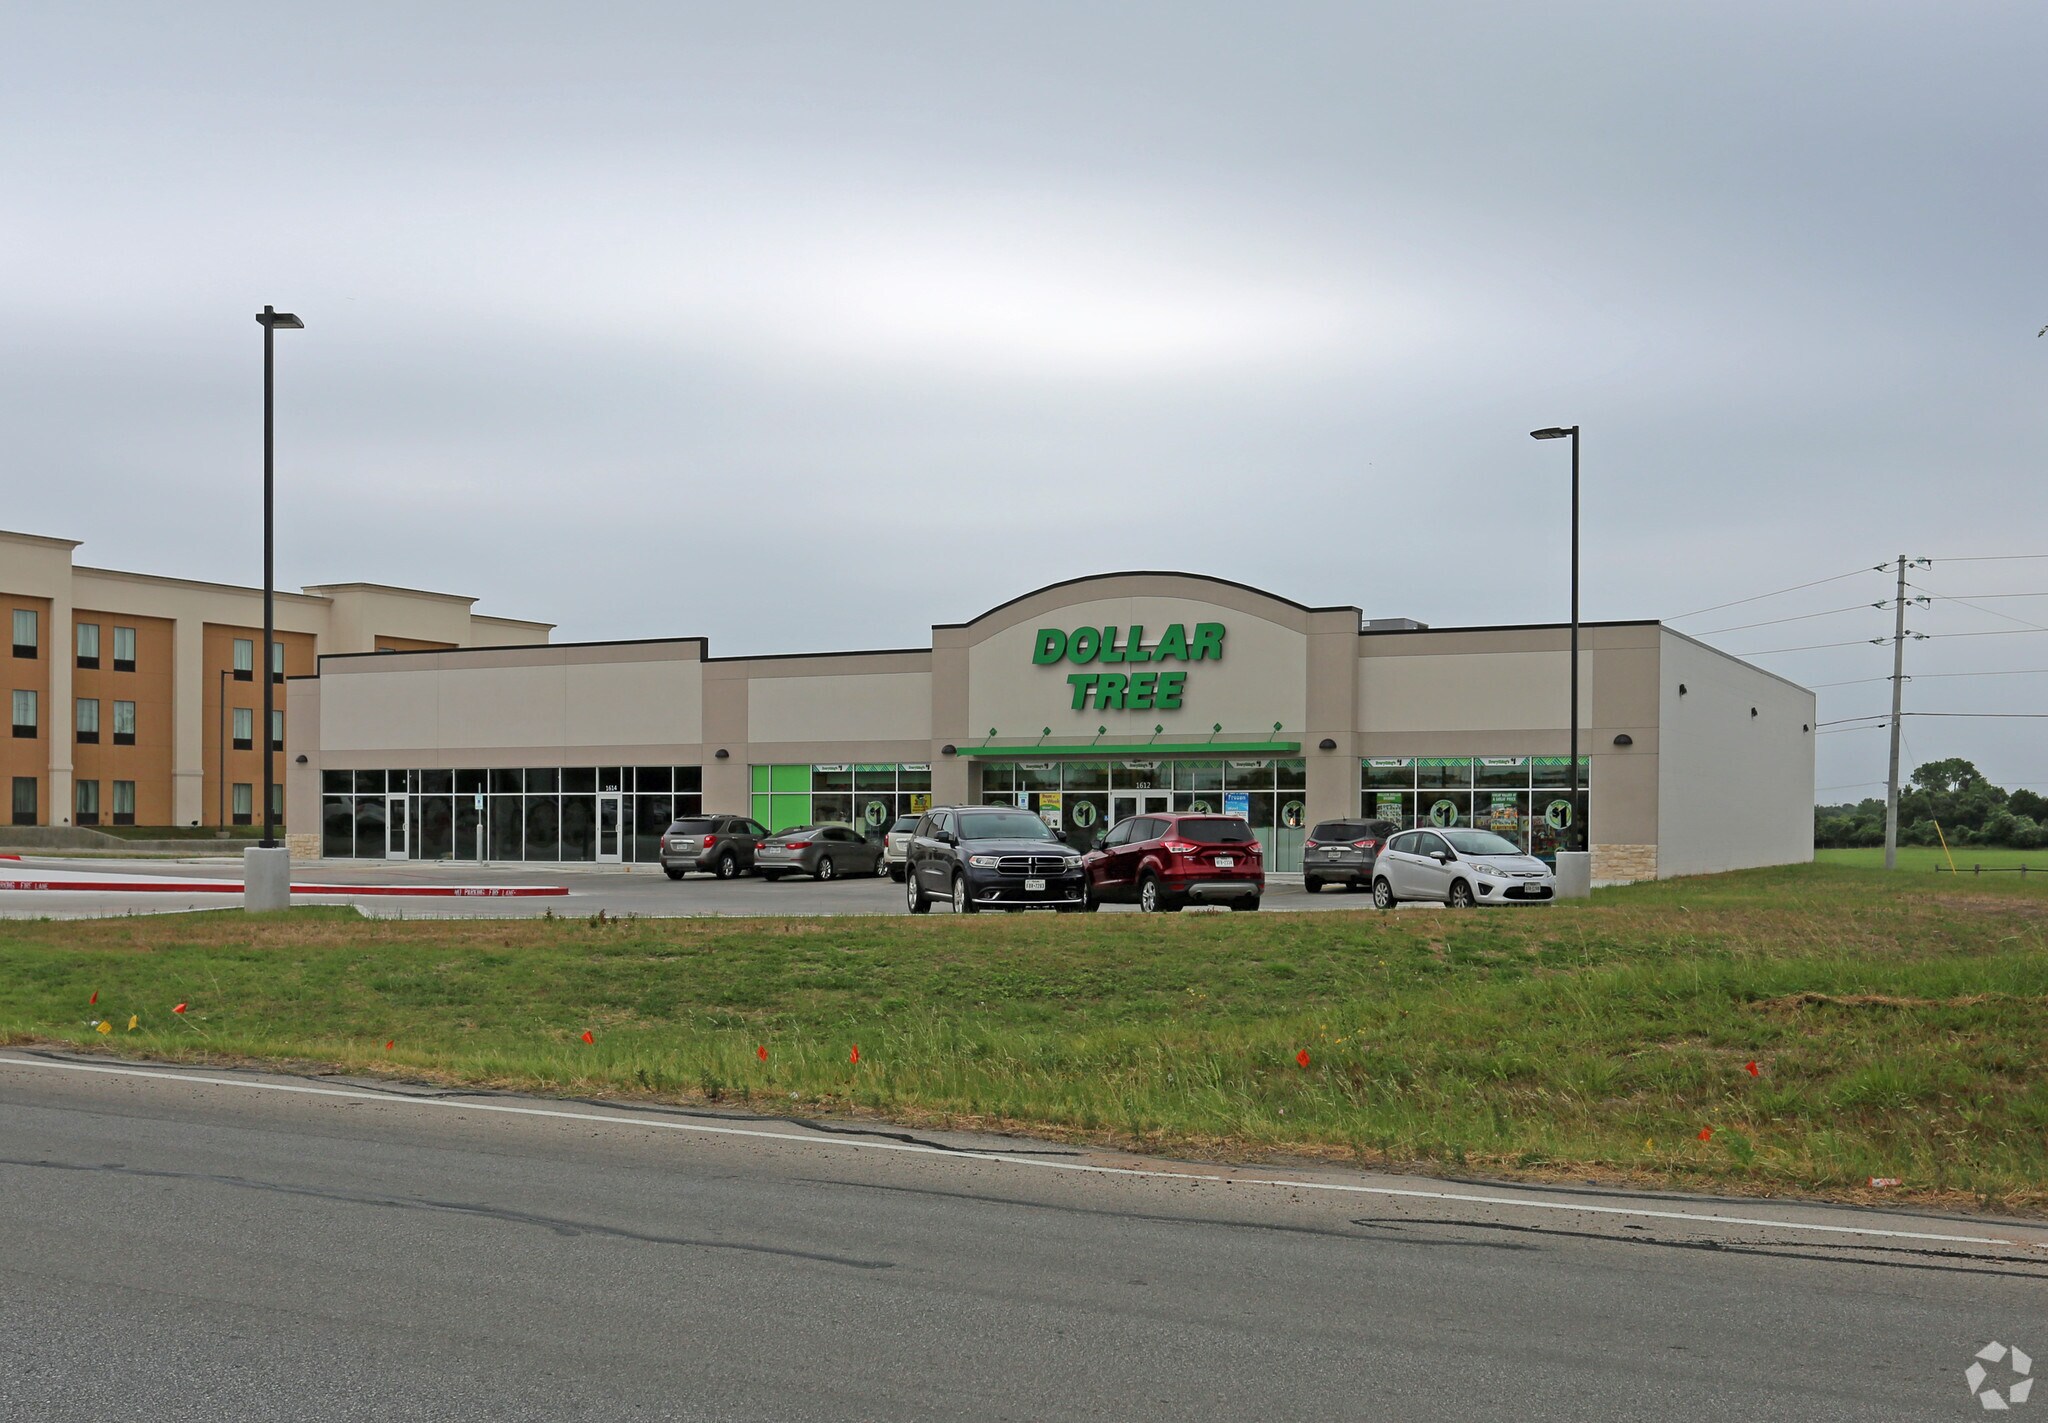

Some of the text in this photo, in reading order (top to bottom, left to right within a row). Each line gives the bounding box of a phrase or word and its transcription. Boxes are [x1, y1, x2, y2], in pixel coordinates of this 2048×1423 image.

[1032, 622, 1226, 665] DOLLAR
[1066, 671, 1188, 710] TREE
[1077, 806, 1090, 826] $1
[1436, 806, 1451, 827] $1
[1551, 805, 1567, 828] $1
